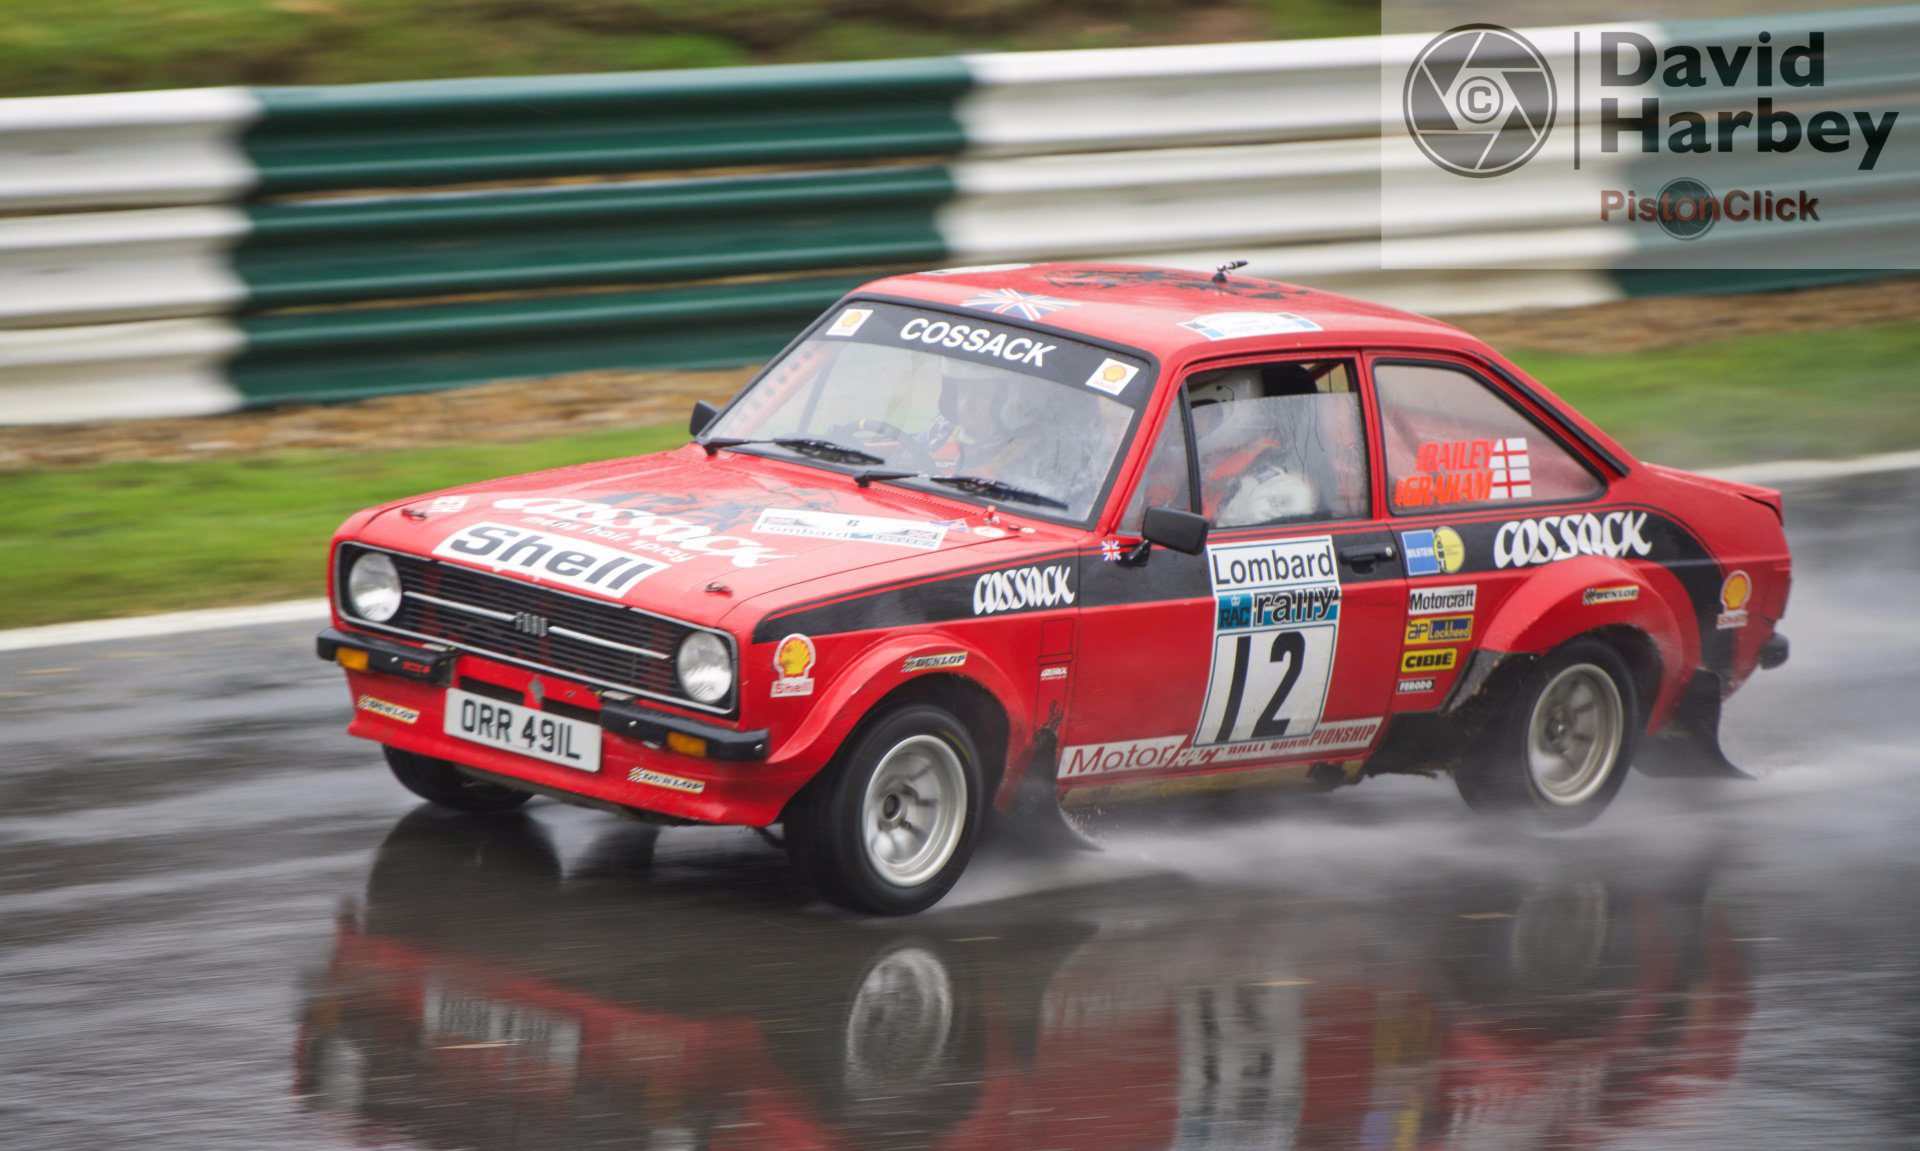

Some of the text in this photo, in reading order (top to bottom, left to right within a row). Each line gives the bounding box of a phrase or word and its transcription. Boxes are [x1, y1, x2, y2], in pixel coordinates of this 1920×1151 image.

[899, 318, 1057, 368] COSSACK
[450, 526, 654, 590] Shell
[628, 535, 697, 563] spray
[1494, 510, 1653, 569] COSSACK
[1212, 544, 1334, 585] Lombard
[973, 564, 1075, 615] COSSACK
[1255, 586, 1338, 625] rally
[1410, 589, 1474, 611] Motorcraft
[1218, 607, 1250, 627] RAC
[1430, 620, 1470, 639] Lockheed
[916, 653, 965, 667] DUNLOP
[1212, 630, 1307, 743] 12
[1399, 680, 1432, 691] FERODO
[461, 699, 581, 761] ORR 491L
